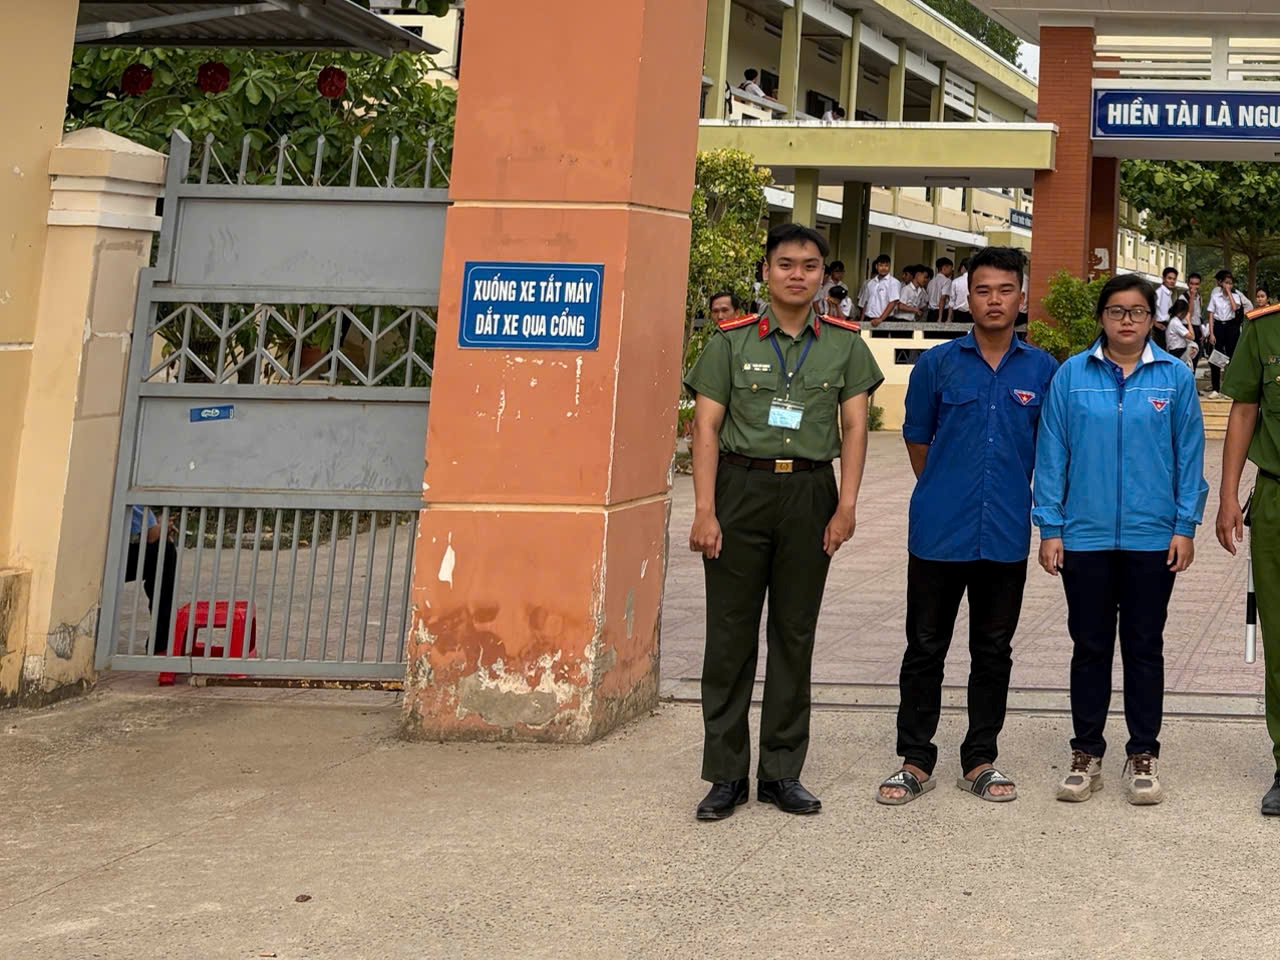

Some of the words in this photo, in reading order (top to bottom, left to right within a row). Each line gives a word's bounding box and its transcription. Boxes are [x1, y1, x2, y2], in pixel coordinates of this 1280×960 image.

[1107, 97, 1159, 126] HIỀN
[1165, 100, 1199, 126] TÀI
[1206, 101, 1231, 126] LÀ
[473, 272, 517, 302] XUỐNG
[519, 280, 537, 302] XE
[539, 273, 563, 303] TẮT
[564, 277, 593, 304] MÁY
[474, 306, 501, 335] DẮT
[501, 314, 520, 336] XE
[521, 314, 547, 338] QUA
[549, 307, 585, 337] CỔNG
